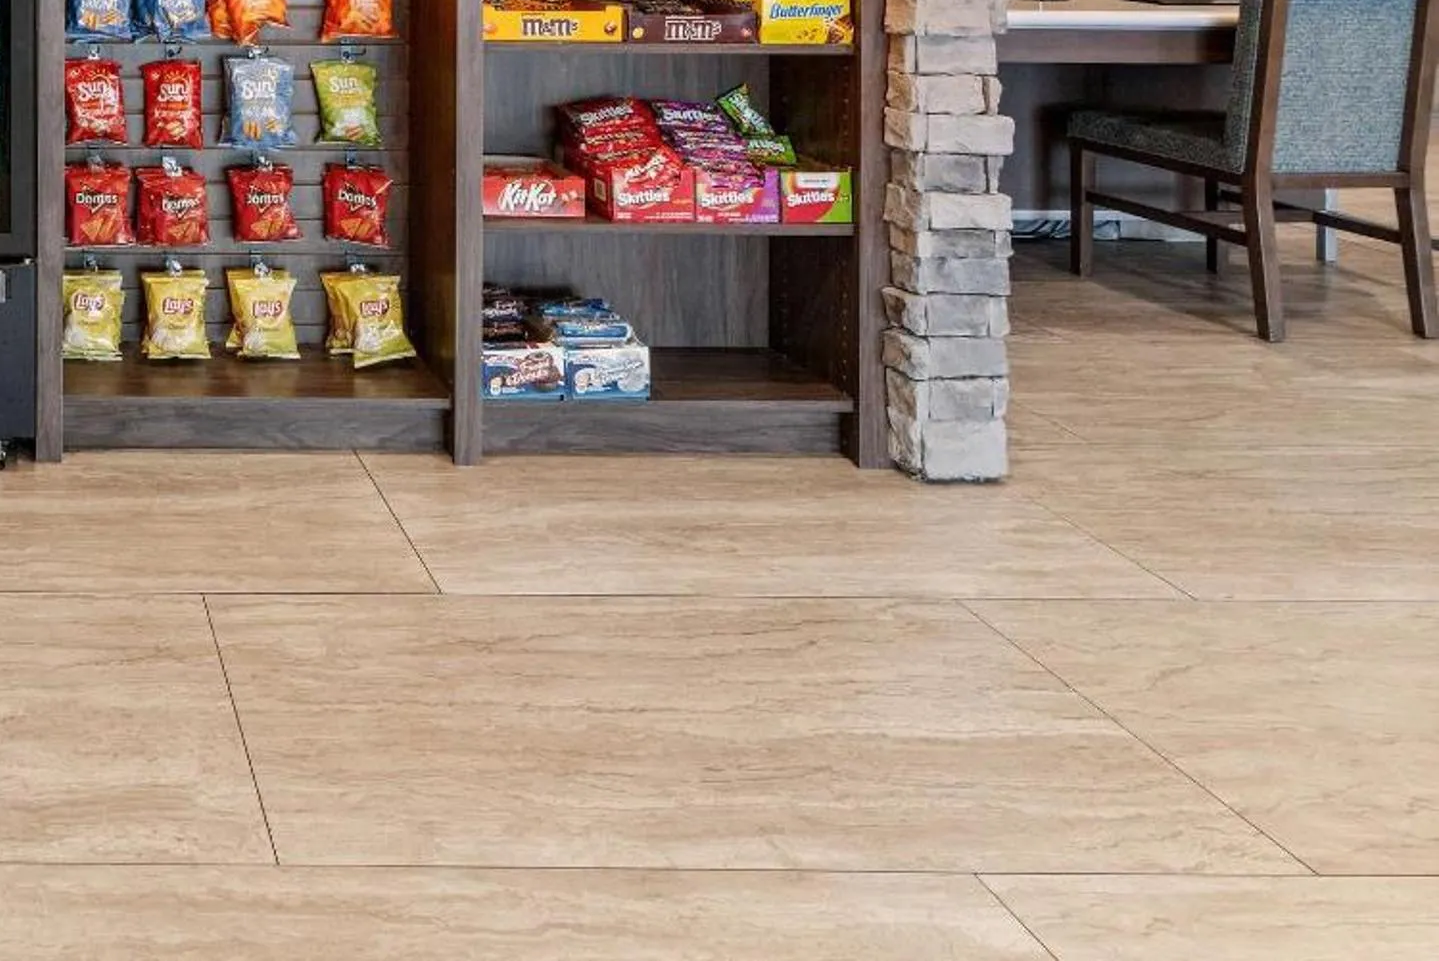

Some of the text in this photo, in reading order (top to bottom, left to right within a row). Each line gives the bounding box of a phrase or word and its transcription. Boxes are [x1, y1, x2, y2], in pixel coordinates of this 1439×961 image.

[770, 4, 844, 20] Butterfinger
[615, 189, 670, 206] Skittles
[700, 190, 755, 208] Skittles
[786, 191, 835, 208] Skittles
